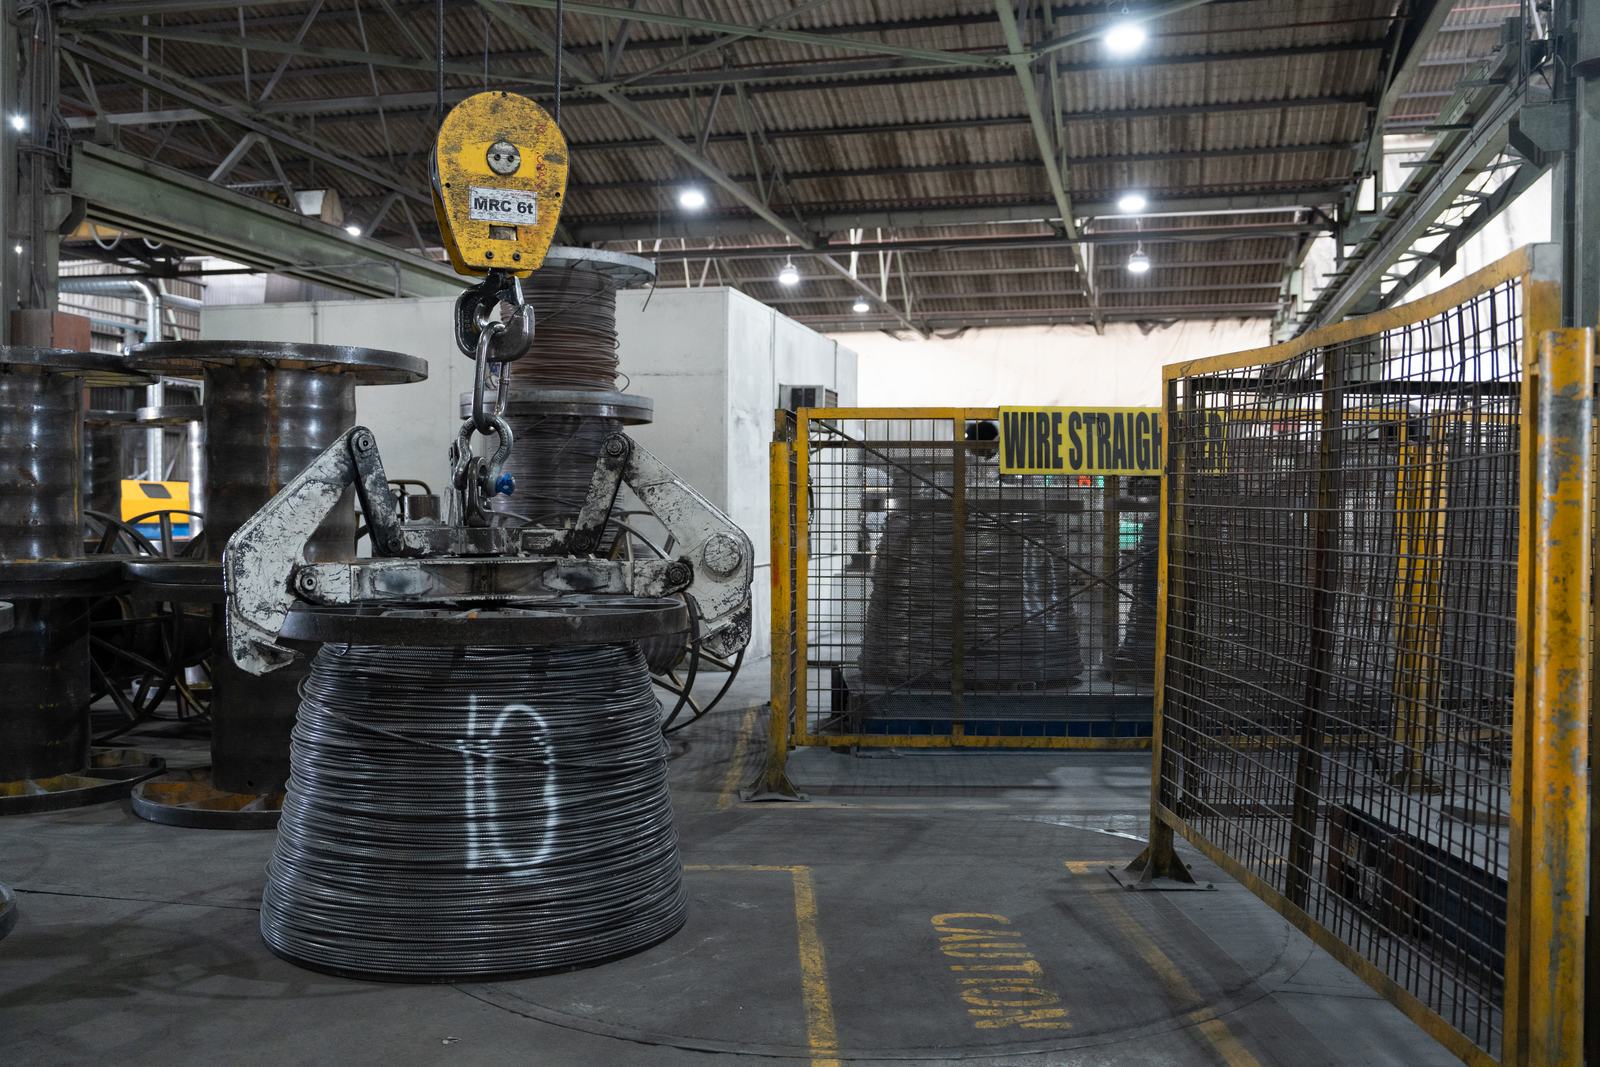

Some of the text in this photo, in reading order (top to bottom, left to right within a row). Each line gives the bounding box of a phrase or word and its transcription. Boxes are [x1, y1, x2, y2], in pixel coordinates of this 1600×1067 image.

[474, 197, 534, 215] MRC 6t
[1003, 411, 1063, 470] WIRE
[930, 912, 1073, 1029] CAUTION
